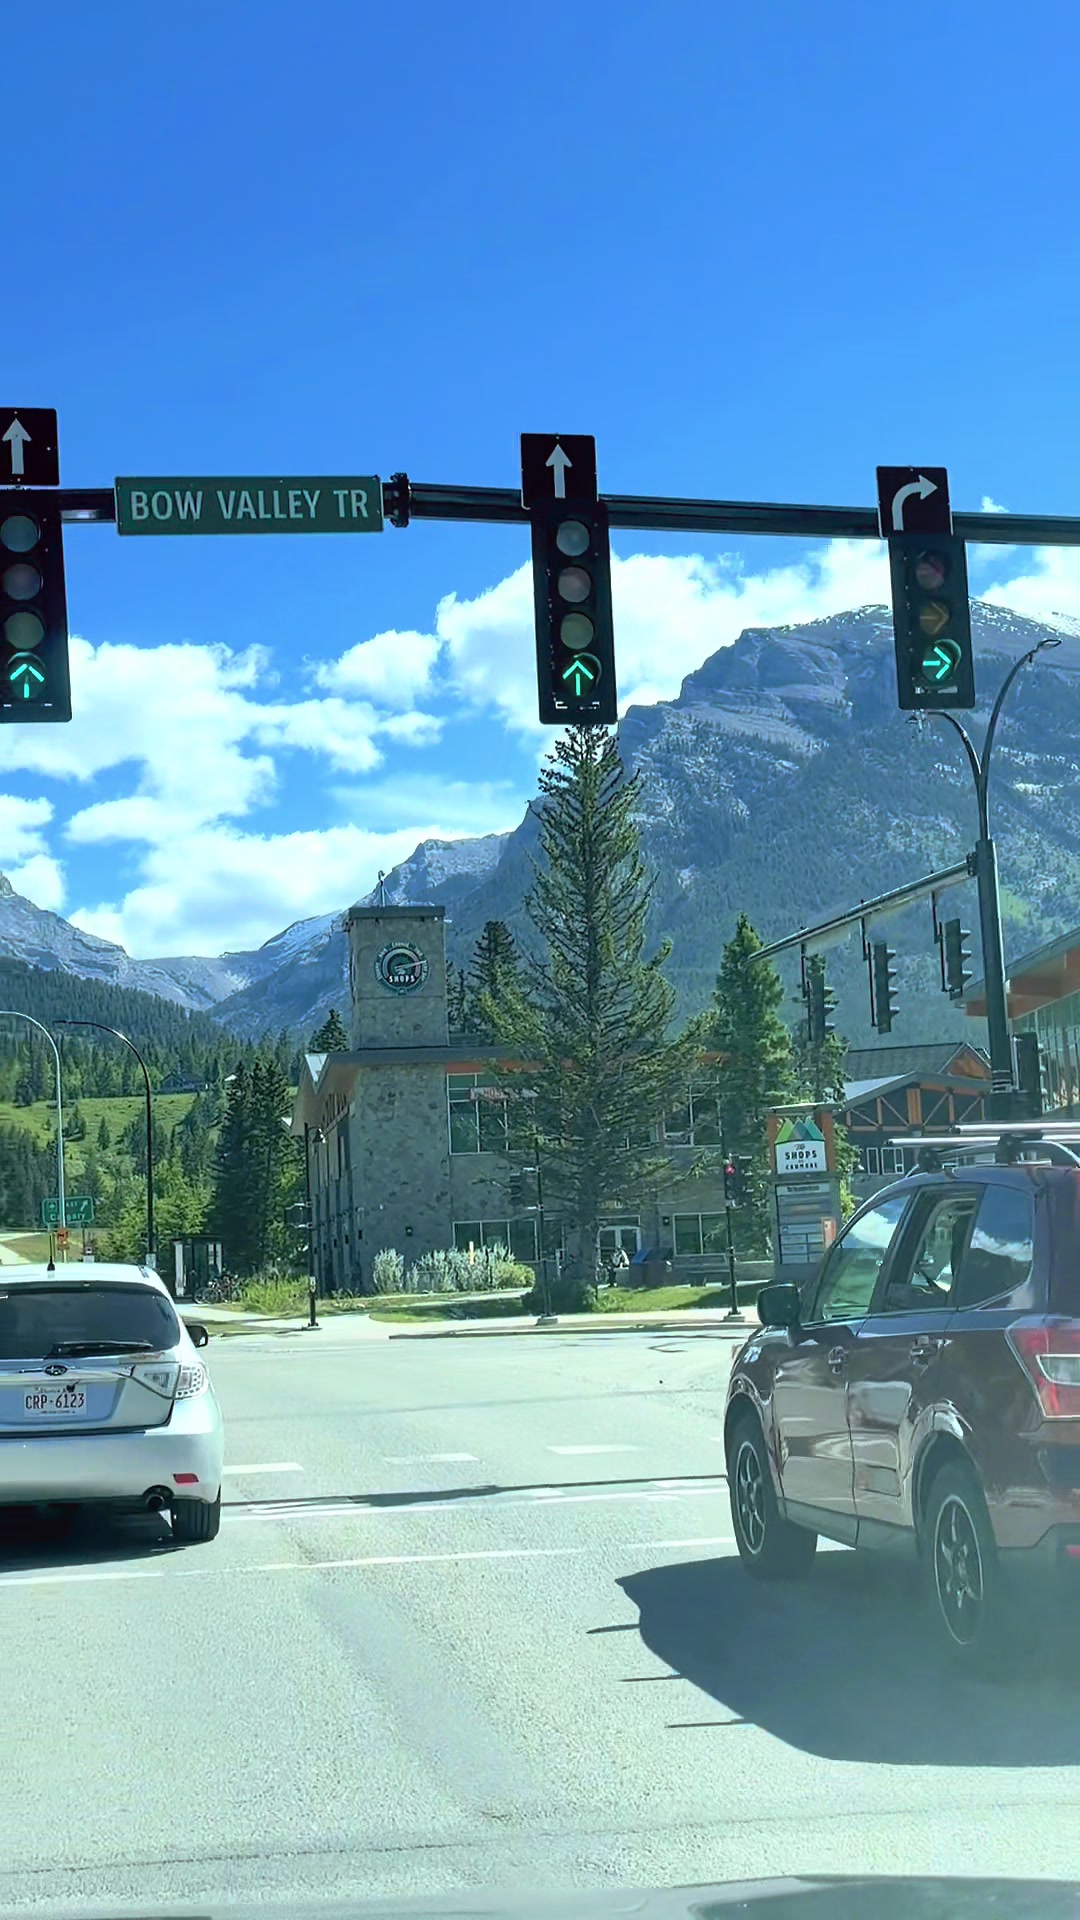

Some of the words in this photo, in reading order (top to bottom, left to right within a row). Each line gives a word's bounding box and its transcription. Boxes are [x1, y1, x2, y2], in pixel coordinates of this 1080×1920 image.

[131, 491, 204, 520] BOW
[216, 490, 321, 519] VALLEY
[333, 490, 369, 519] TR
[785, 1150, 818, 1160] SHOPS
[26, 1393, 85, 1410] CRP-6123
